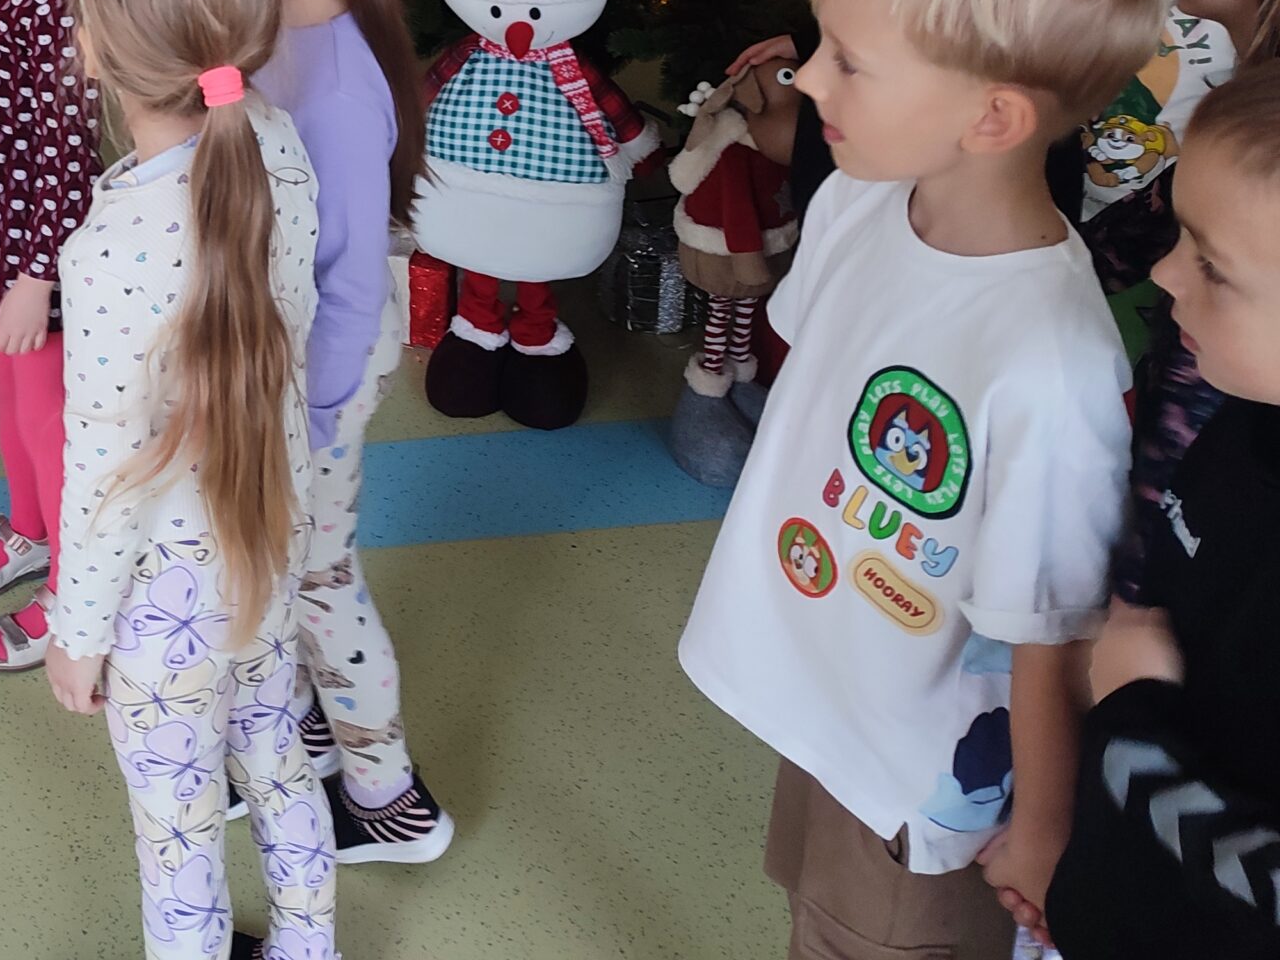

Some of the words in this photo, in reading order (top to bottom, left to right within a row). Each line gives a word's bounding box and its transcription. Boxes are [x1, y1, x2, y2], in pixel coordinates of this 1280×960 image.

[1167, 9, 1213, 66] AY!
[822, 467, 960, 578] BLUEY
[863, 566, 926, 619] HOORAY
